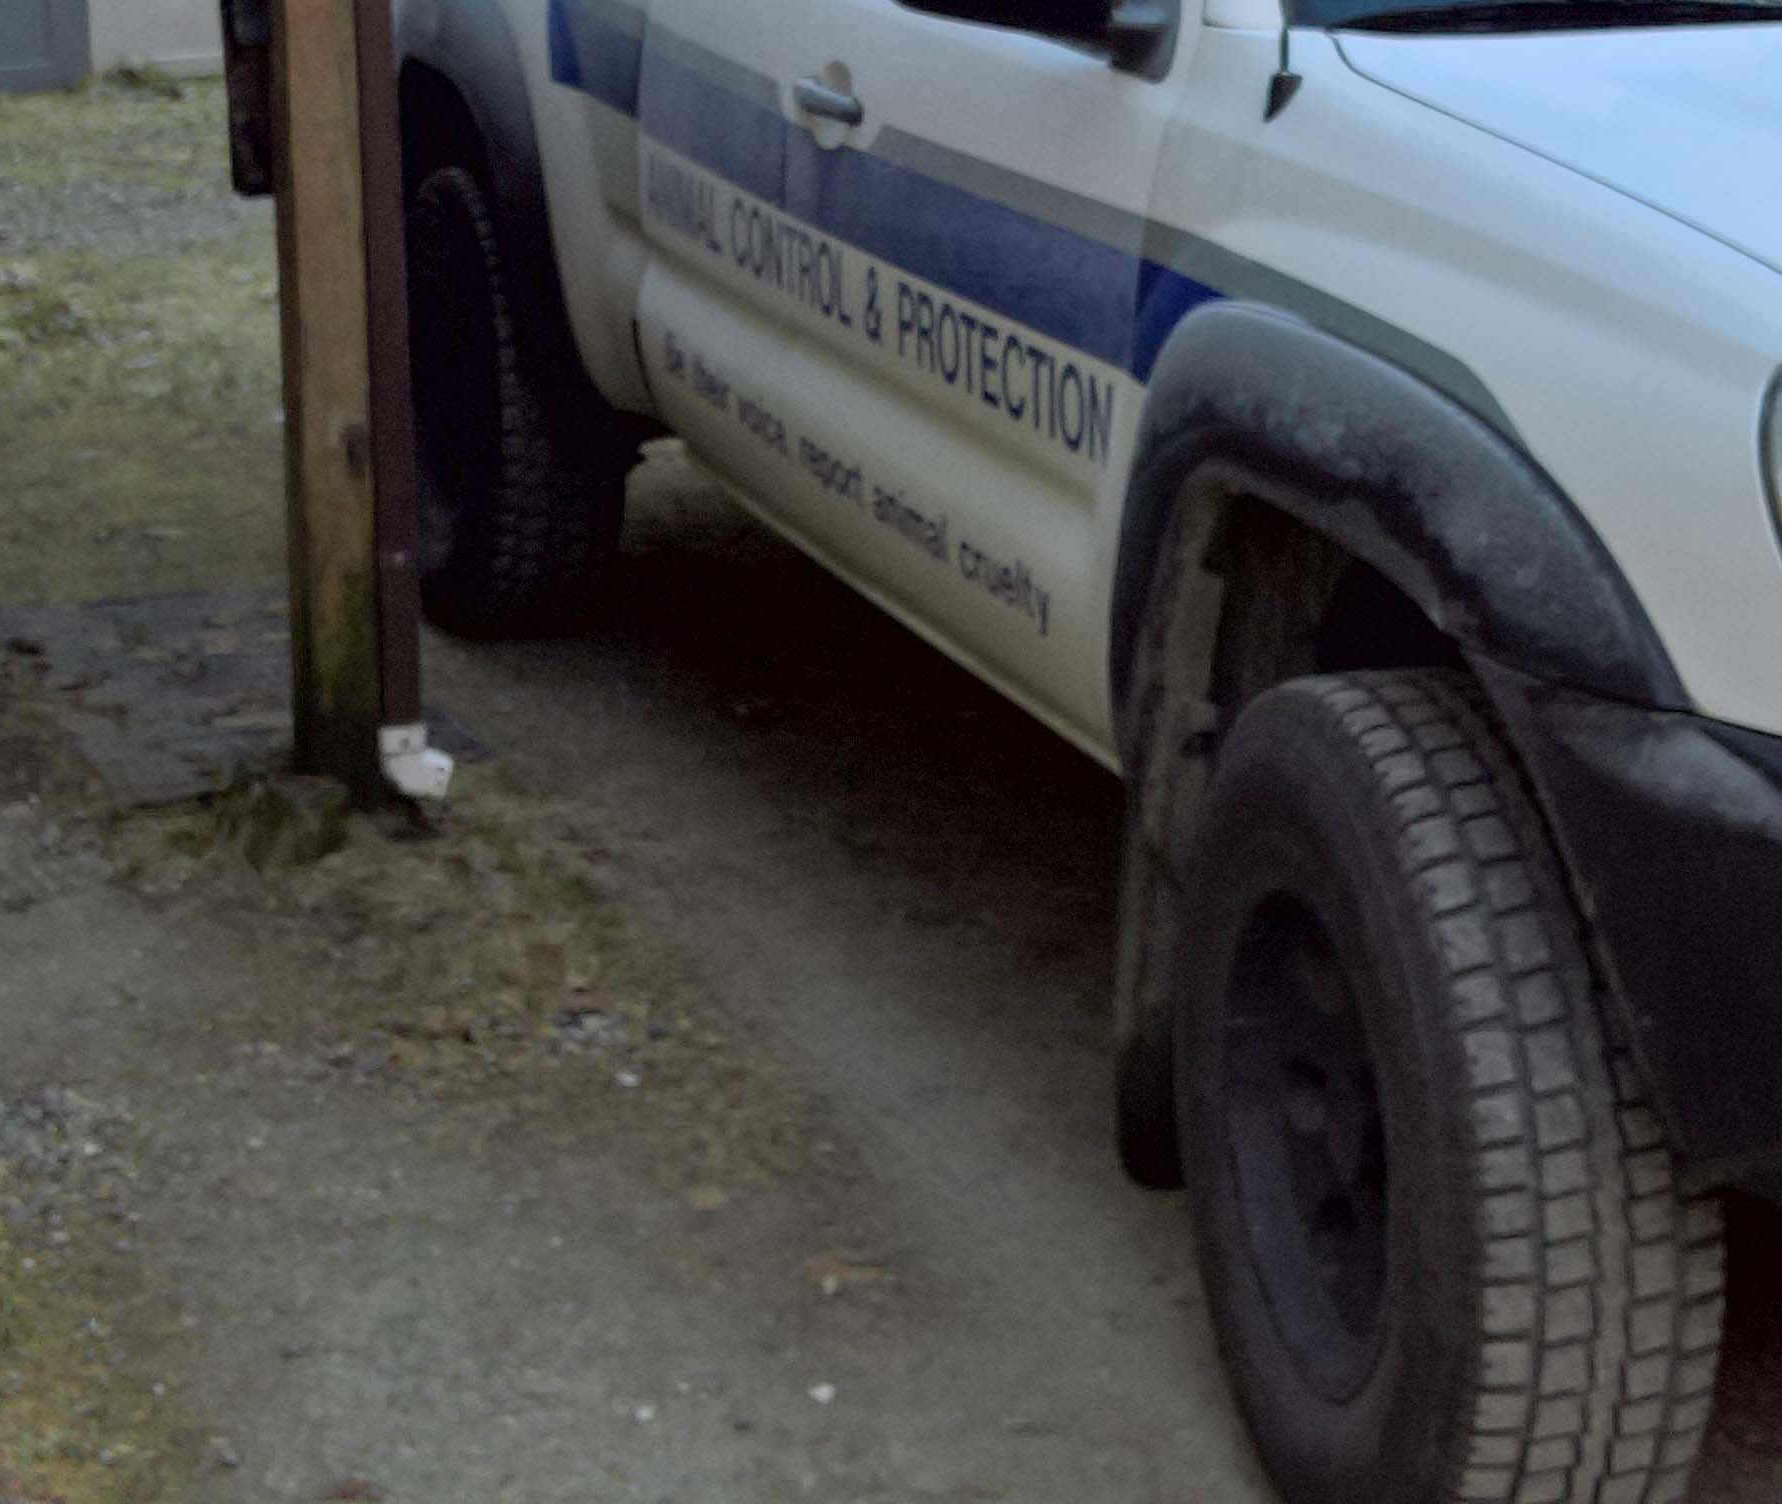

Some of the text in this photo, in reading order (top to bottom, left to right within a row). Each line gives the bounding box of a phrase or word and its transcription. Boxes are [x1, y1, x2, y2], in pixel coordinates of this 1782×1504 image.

[730, 196, 851, 328] CONTROL
[866, 264, 883, 344] &
[897, 280, 1114, 466] PROTECTION
[873, 484, 949, 564] animal
[959, 540, 1050, 638] cruelty
